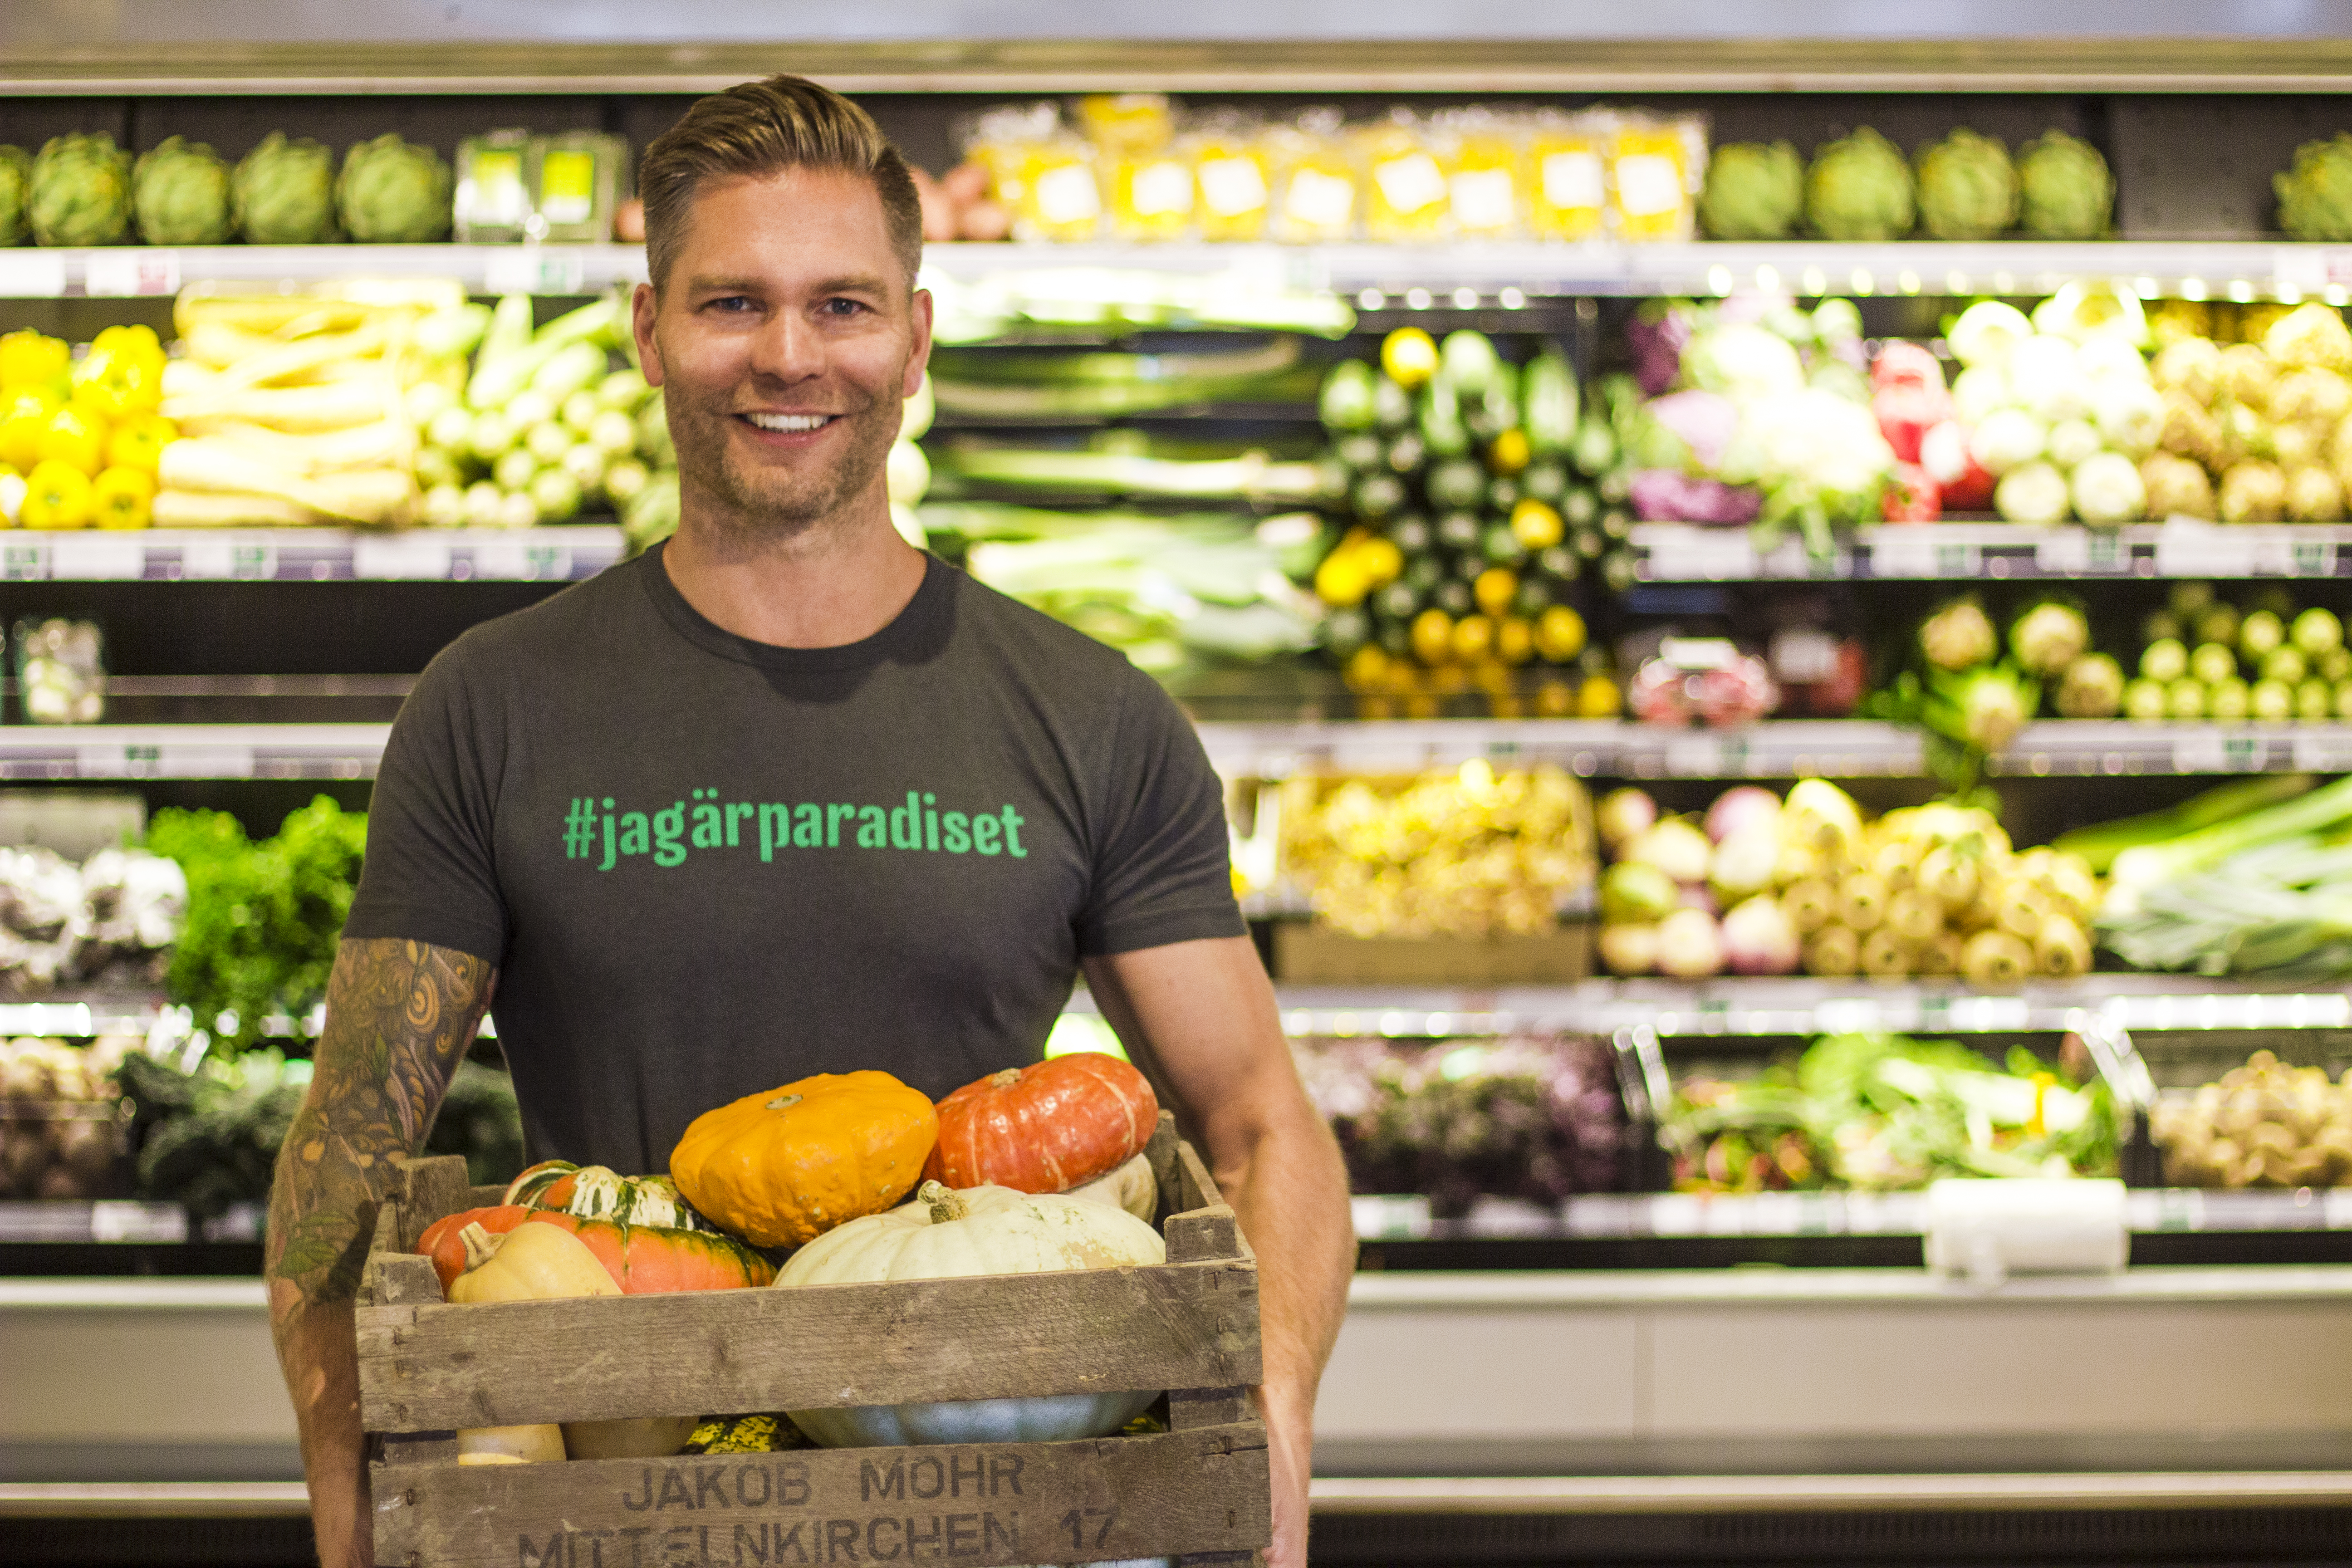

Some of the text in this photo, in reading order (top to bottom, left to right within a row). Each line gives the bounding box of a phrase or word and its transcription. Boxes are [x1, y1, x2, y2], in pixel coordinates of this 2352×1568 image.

[563, 788, 1027, 871] #jagärparadiset
[622, 1453, 1025, 1511] JAKOB MOHR
[1061, 1506, 1120, 1549] 17
